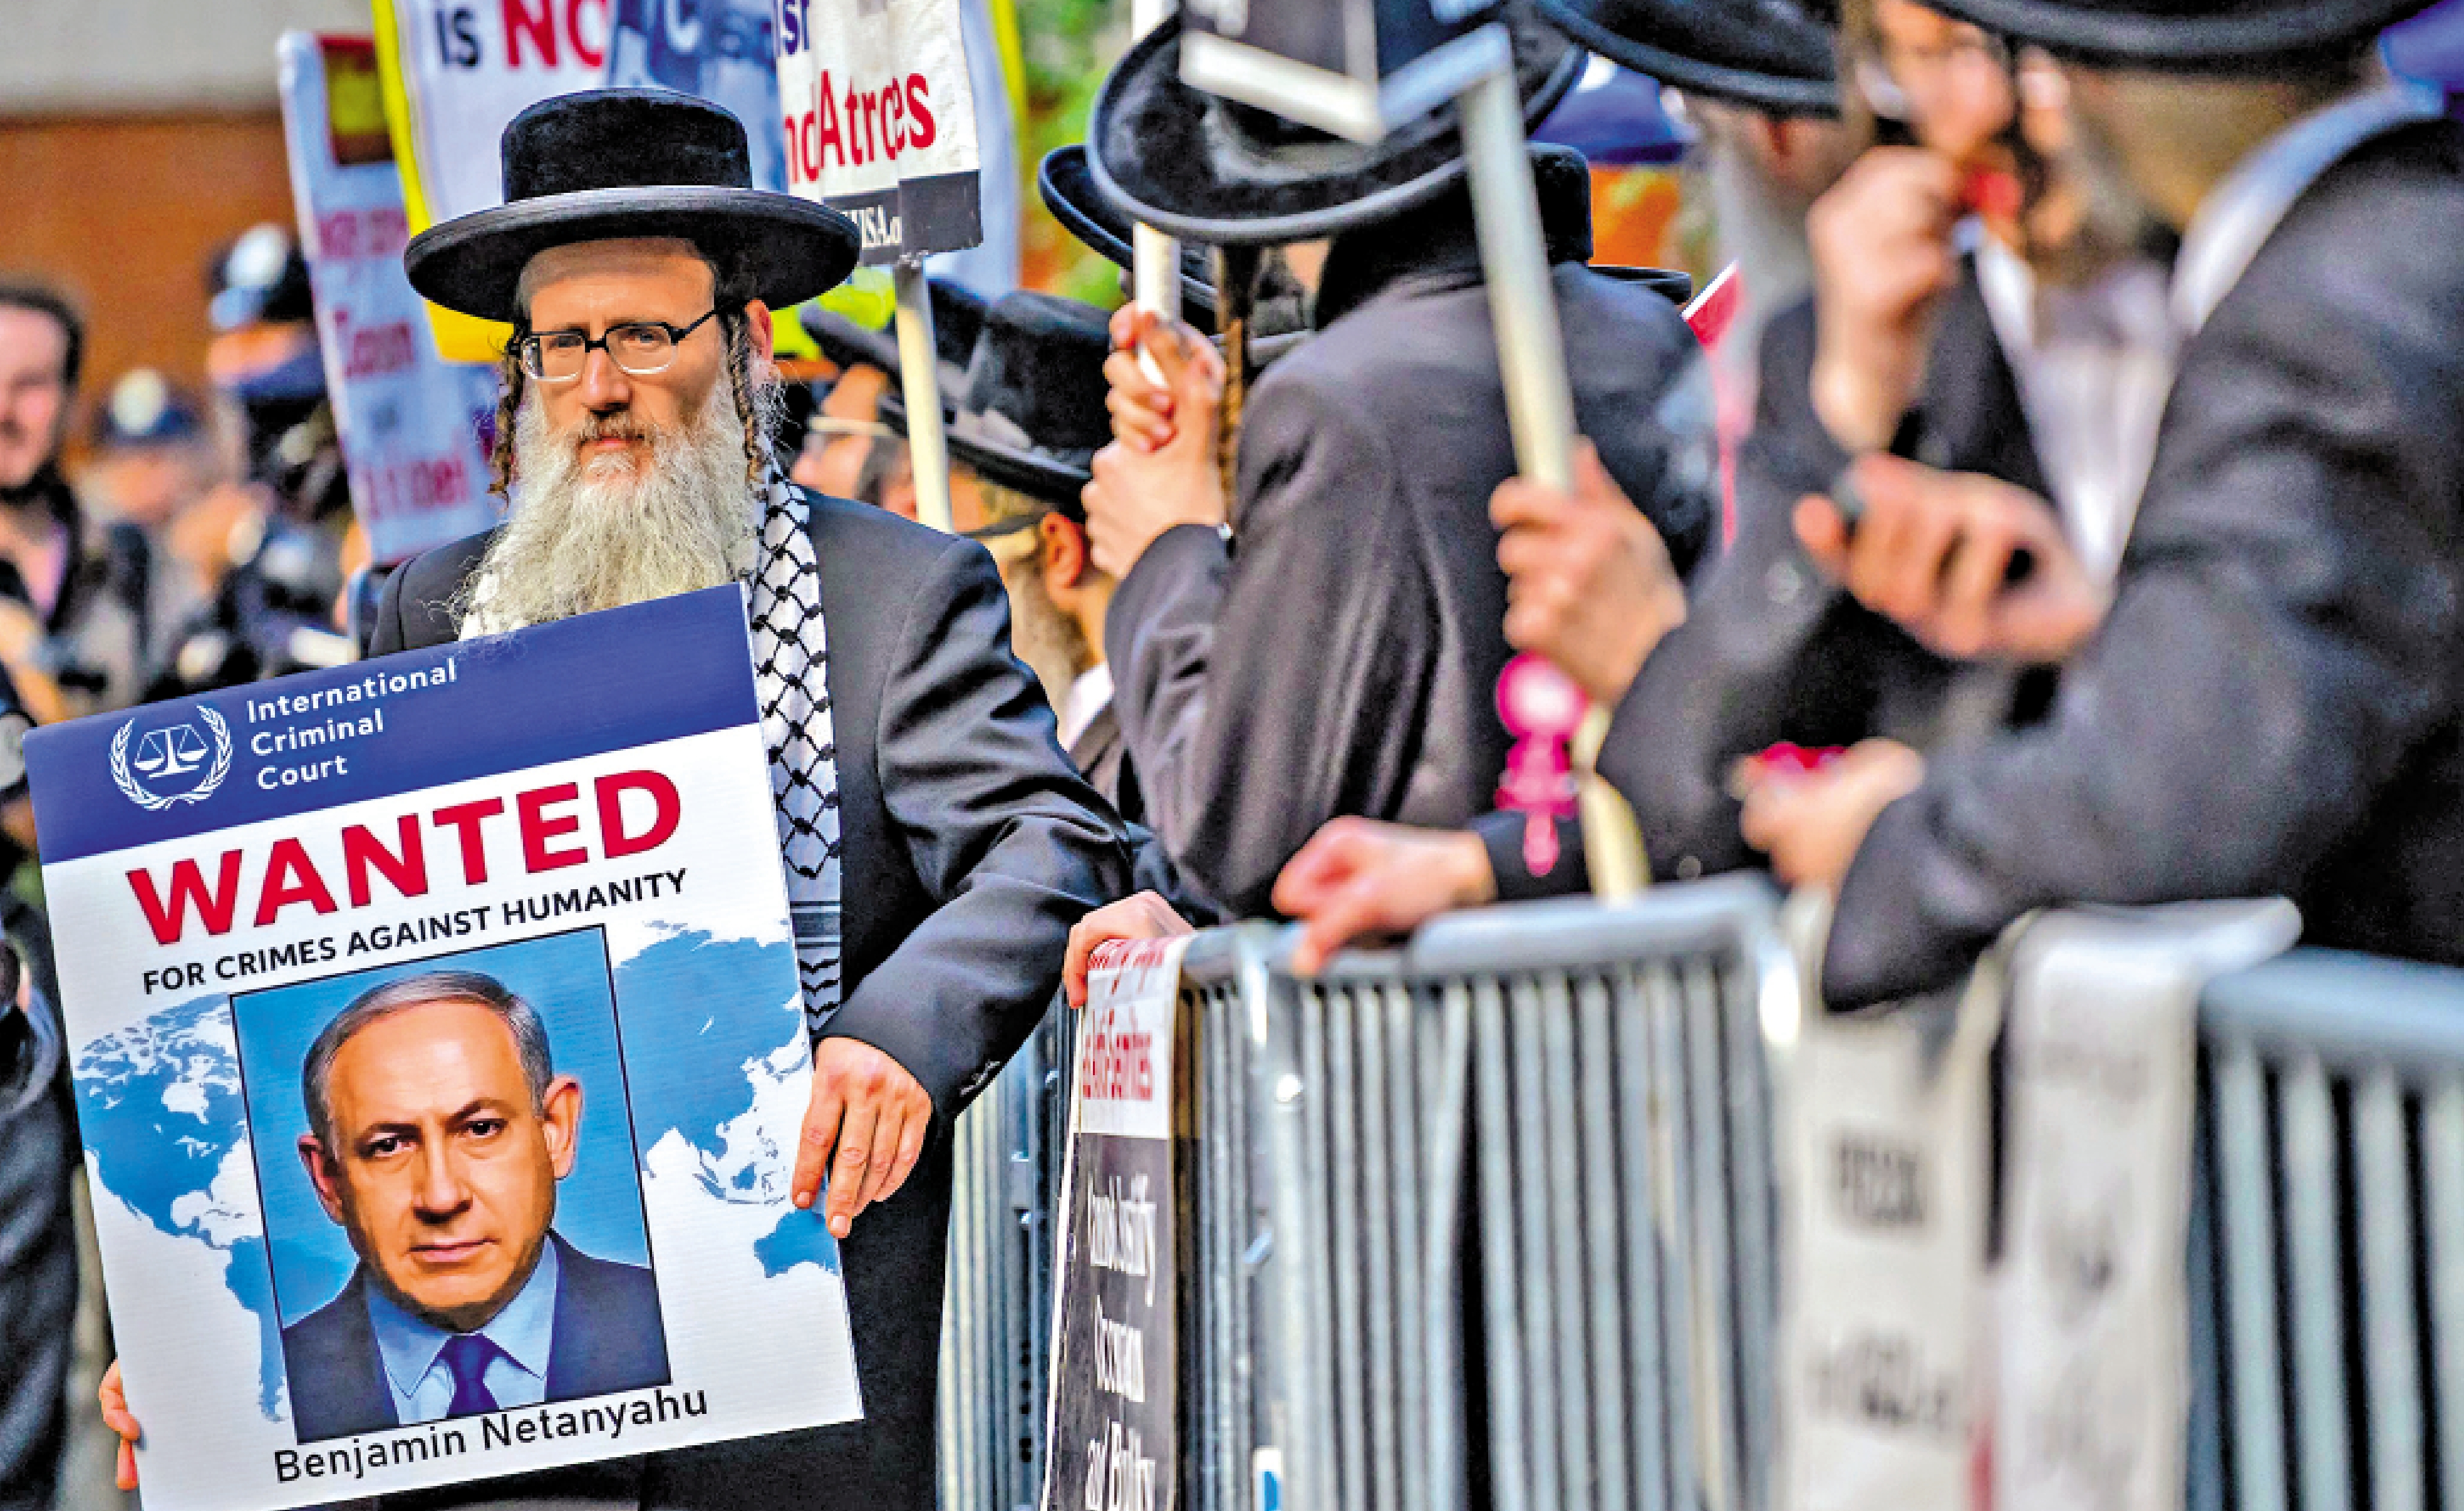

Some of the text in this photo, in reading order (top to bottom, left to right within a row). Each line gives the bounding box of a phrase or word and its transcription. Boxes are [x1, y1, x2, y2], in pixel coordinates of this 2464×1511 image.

[433, 7, 481, 68] IS
[501, 0, 608, 70] NO
[247, 657, 457, 723] International
[251, 708, 383, 756] Criminal
[256, 755, 348, 790] Court
[127, 769, 681, 946] WANTED
[142, 868, 686, 994] FOR CRIMES AGAINST HUMANITY
[274, 1388, 707, 1483] Benjamin Netanyahu
